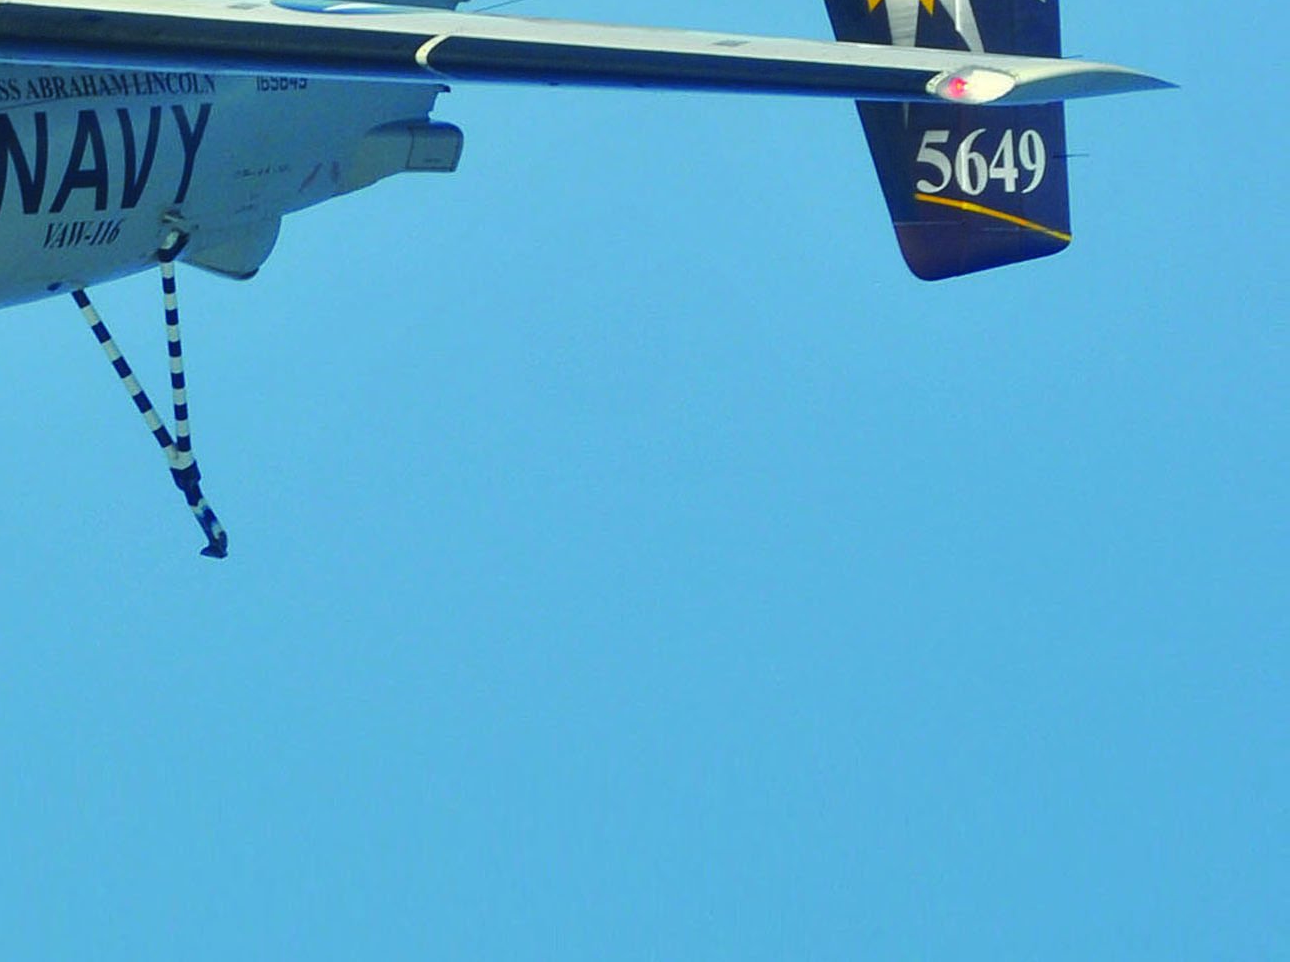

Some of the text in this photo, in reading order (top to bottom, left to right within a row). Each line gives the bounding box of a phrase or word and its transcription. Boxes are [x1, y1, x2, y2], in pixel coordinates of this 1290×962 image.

[26, 74, 129, 99] ABRAHAM
[132, 72, 216, 95] LINCOLN
[916, 128, 1046, 196] 5649
[43, 219, 126, 249] VAW-116
